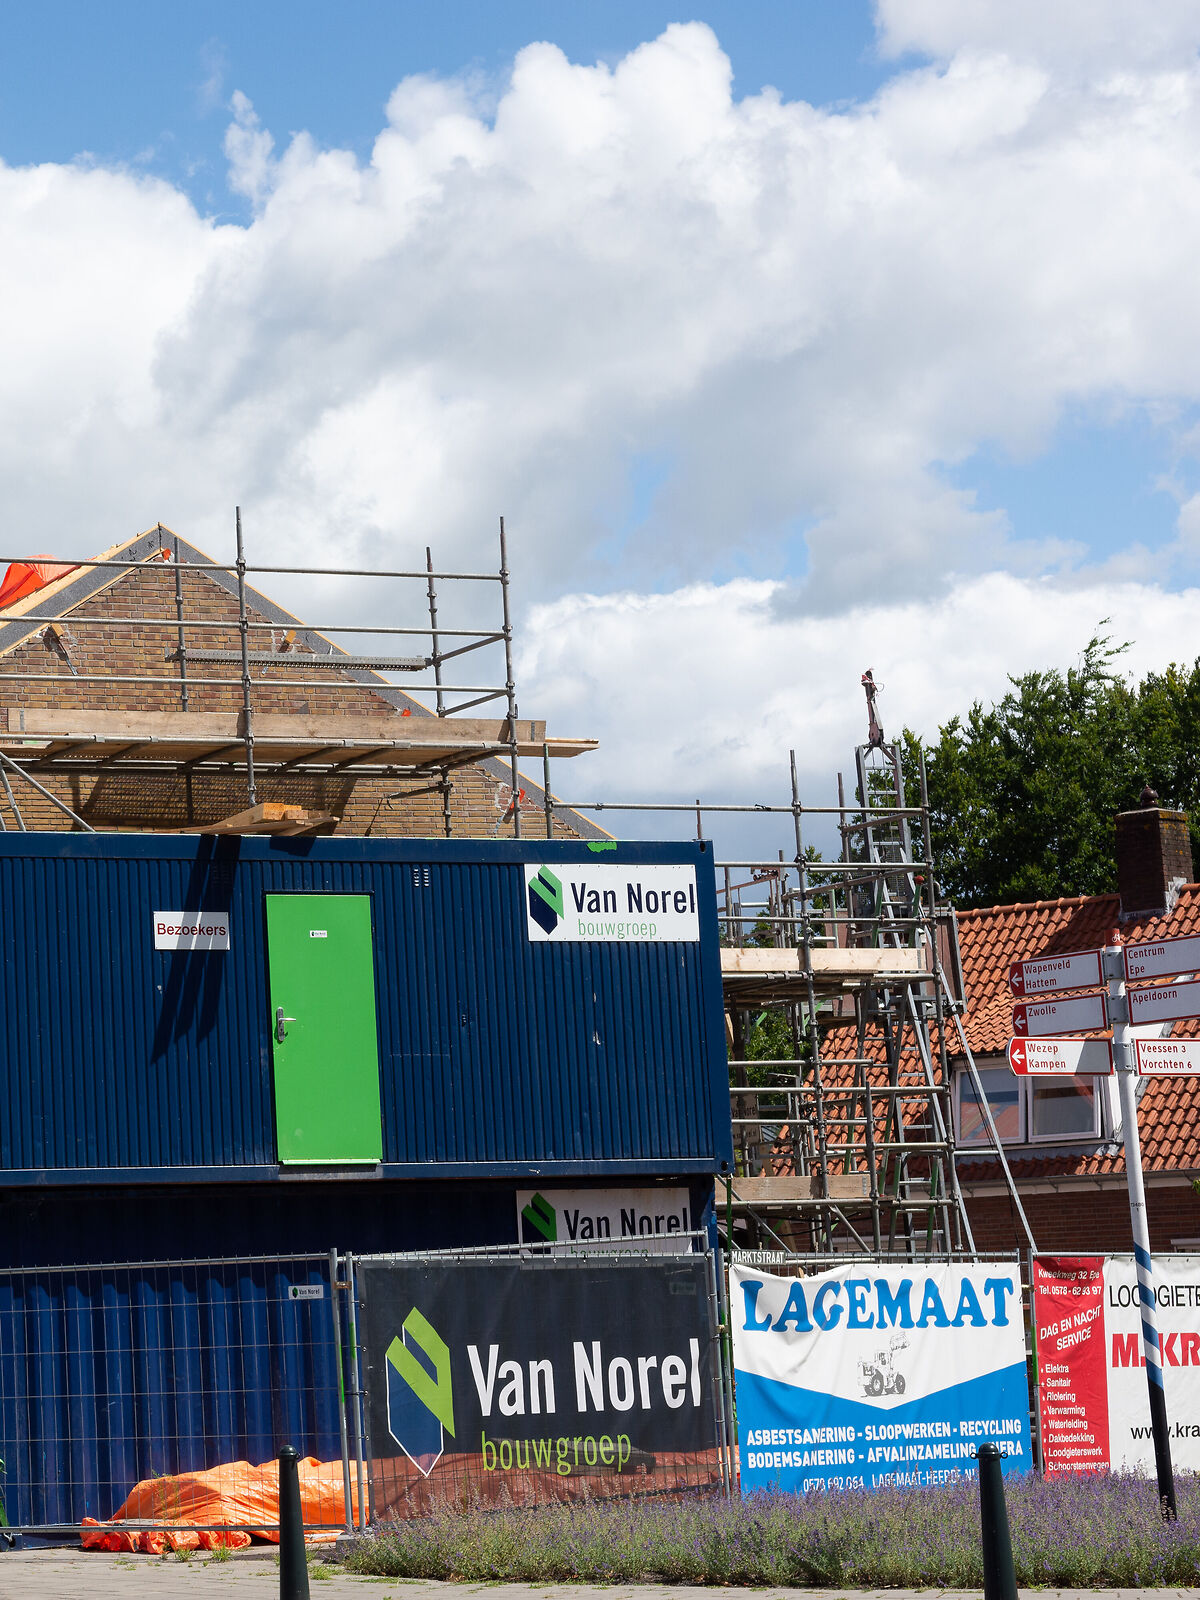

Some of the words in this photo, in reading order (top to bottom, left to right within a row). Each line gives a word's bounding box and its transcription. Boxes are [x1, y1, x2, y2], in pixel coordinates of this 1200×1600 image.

[570, 882, 617, 913] Van
[626, 883, 695, 914] Norel
[157, 923, 227, 936] Bezoekers
[578, 918, 657, 940] bouwgroep
[1128, 947, 1165, 960] Centrum
[1024, 960, 1071, 975] Wapenveld
[1129, 965, 1145, 976] Epe
[1025, 978, 1057, 990] Hattem
[1132, 990, 1178, 1005] Apeldoorn
[1028, 1005, 1057, 1017] Zwolle
[1027, 1043, 1059, 1055] Wezep
[1140, 1044, 1178, 1053] Veessen
[1181, 1045, 1186, 1053] 3
[1028, 1059, 1066, 1070] Kampen
[1142, 1060, 1184, 1069] Vorchten
[1187, 1060, 1193, 1069] 6
[563, 1209, 611, 1241] Van
[620, 1207, 688, 1238] Norel
[731, 1250, 784, 1264] MARKTSTRAAT
[1038, 1268, 1077, 1281] Kweekweg
[1078, 1270, 1088, 1279] 32
[1089, 1270, 1100, 1280] Epe
[1072, 1286, 1082, 1295] 62
[1092, 1286, 1102, 1295] 97
[1109, 1284, 1200, 1308] LOOGIETE
[739, 1277, 1014, 1333] LAGEMAAT
[1040, 1322, 1059, 1340] DAG
[1060, 1317, 1072, 1332] EN
[1073, 1305, 1102, 1327] NACHT
[1056, 1327, 1091, 1351] SERVICE
[1045, 1364, 1069, 1373] Elektra
[467, 1344, 556, 1417] Van
[573, 1338, 701, 1413] Norel
[1046, 1378, 1071, 1387] Sanitair
[1046, 1392, 1076, 1402] Riolering
[1047, 1405, 1085, 1416] Verwarming
[1048, 1420, 1088, 1430] Waterleiding
[746, 1426, 855, 1446] ASBESTSANERING
[865, 1422, 951, 1441] SLOOPWERKEN
[959, 1419, 1022, 1436] RECYCLING
[1048, 1433, 1095, 1444] Dakbedekking
[481, 1431, 631, 1476] bouwgroep
[747, 1448, 855, 1468] BODEMSANERING
[867, 1442, 977, 1463] AFVALINZAMELING
[1048, 1447, 1103, 1459] Loodgieterswerk
